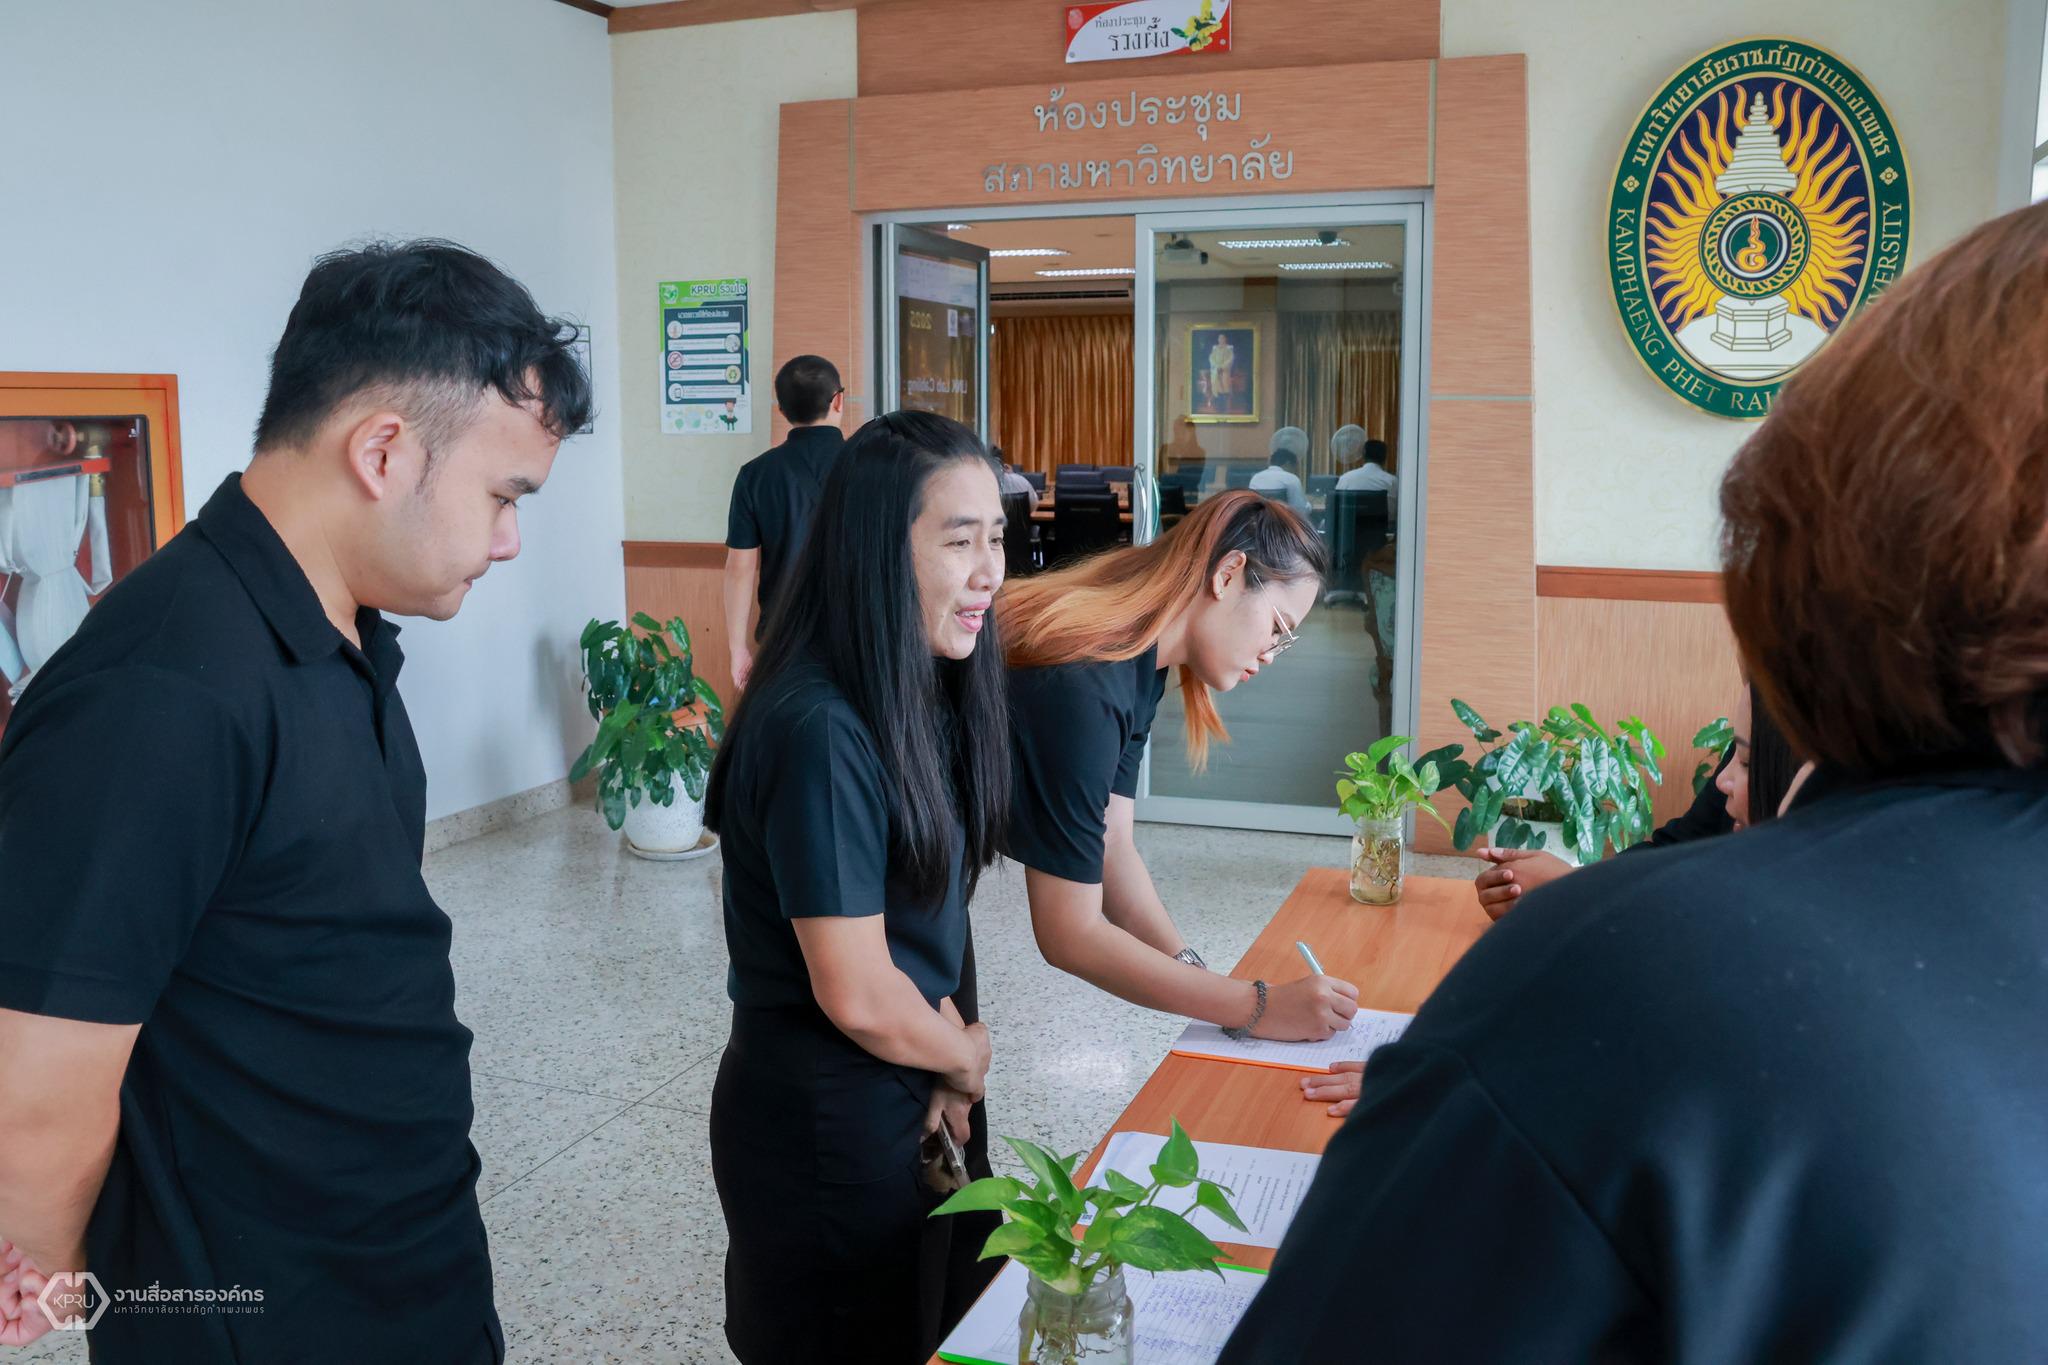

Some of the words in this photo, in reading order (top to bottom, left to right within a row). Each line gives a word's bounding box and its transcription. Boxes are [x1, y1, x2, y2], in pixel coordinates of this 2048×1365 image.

[1095, 14, 1147, 28] ห้องประชุม
[1107, 16, 1169, 51] รวงผึ้ง
[1034, 87, 1241, 141] ห้องประชุม
[982, 133, 1294, 193] สภามหาวิทยาลัย
[691, 283, 717, 296] KPRU
[1615, 208, 1666, 356] KAMPHAENG
[1661, 357, 1721, 403] PHET
[1866, 200, 1902, 304] VERSITY
